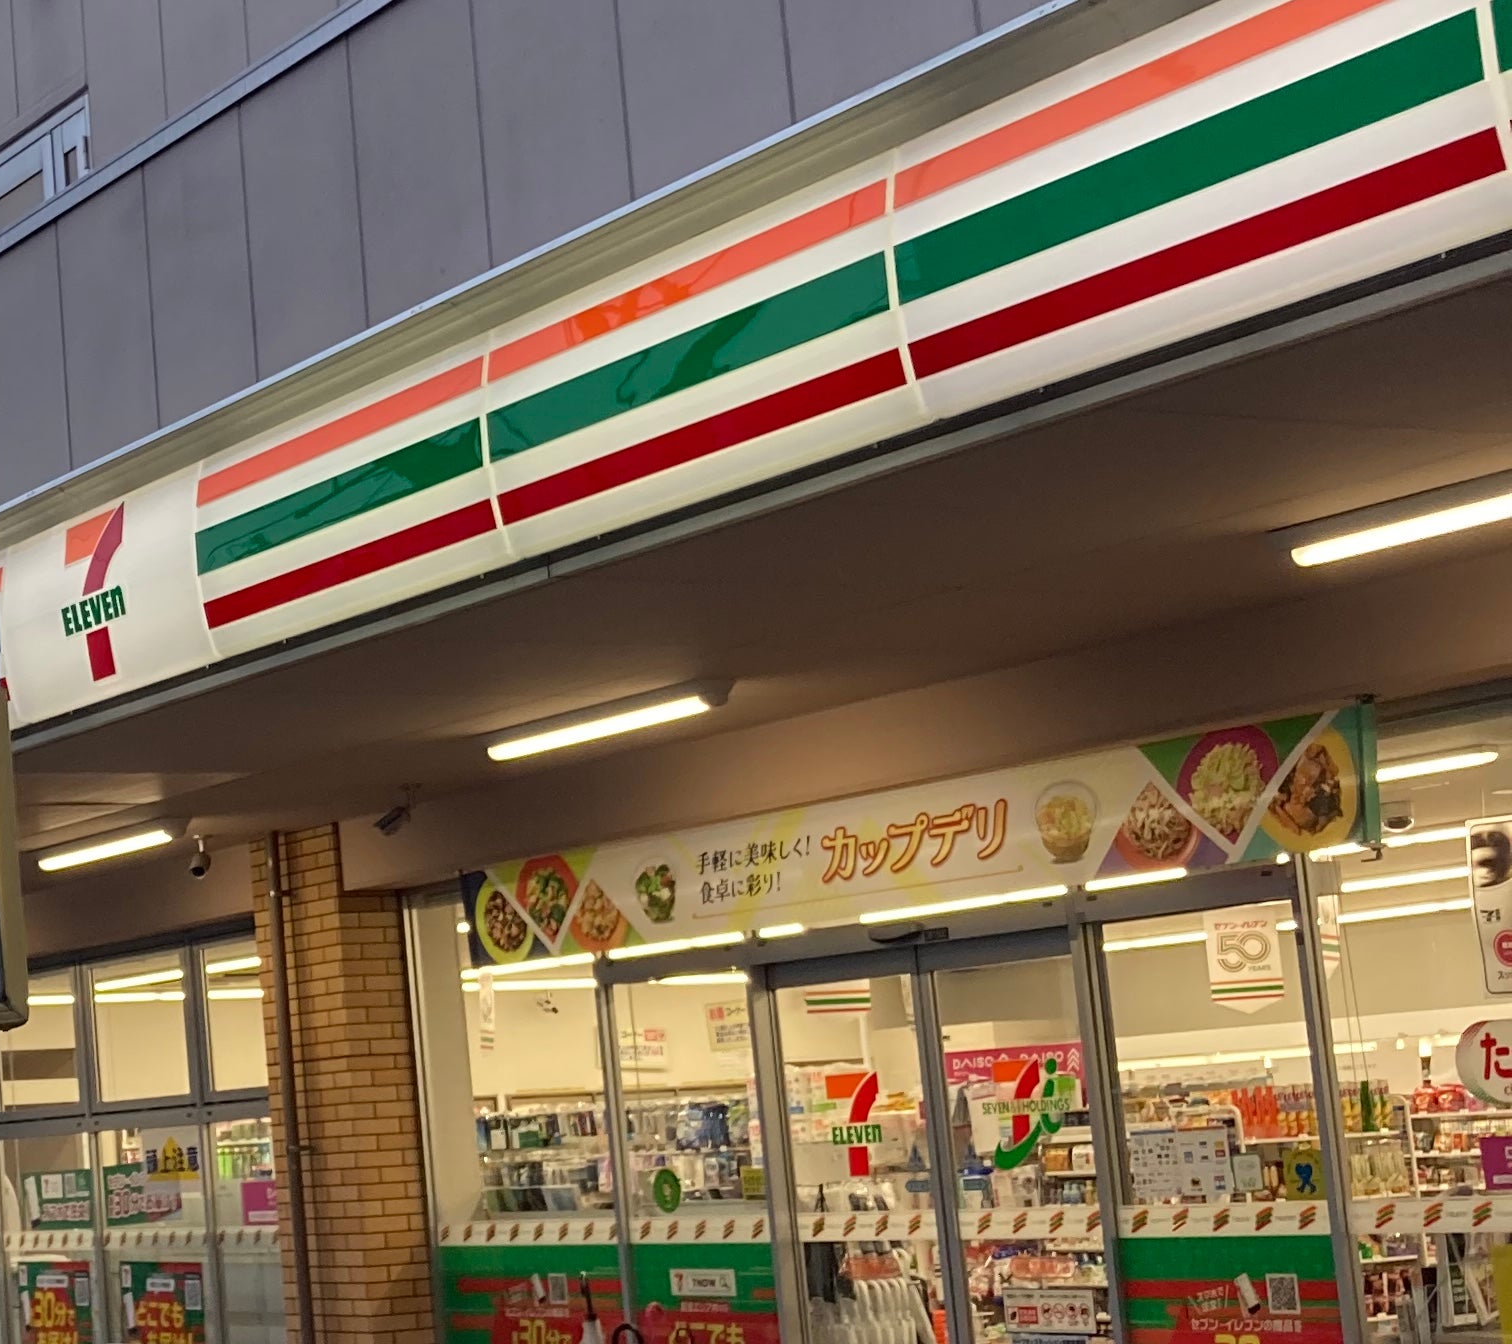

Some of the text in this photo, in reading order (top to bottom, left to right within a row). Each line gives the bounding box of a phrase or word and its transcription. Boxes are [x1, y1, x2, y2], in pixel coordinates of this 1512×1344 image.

[821, 798, 1008, 885] カップデリ
[1216, 930, 1272, 973] 50
[1022, 1098, 1071, 1113] HOLDINGS
[136, 1301, 185, 1328] どこでも
